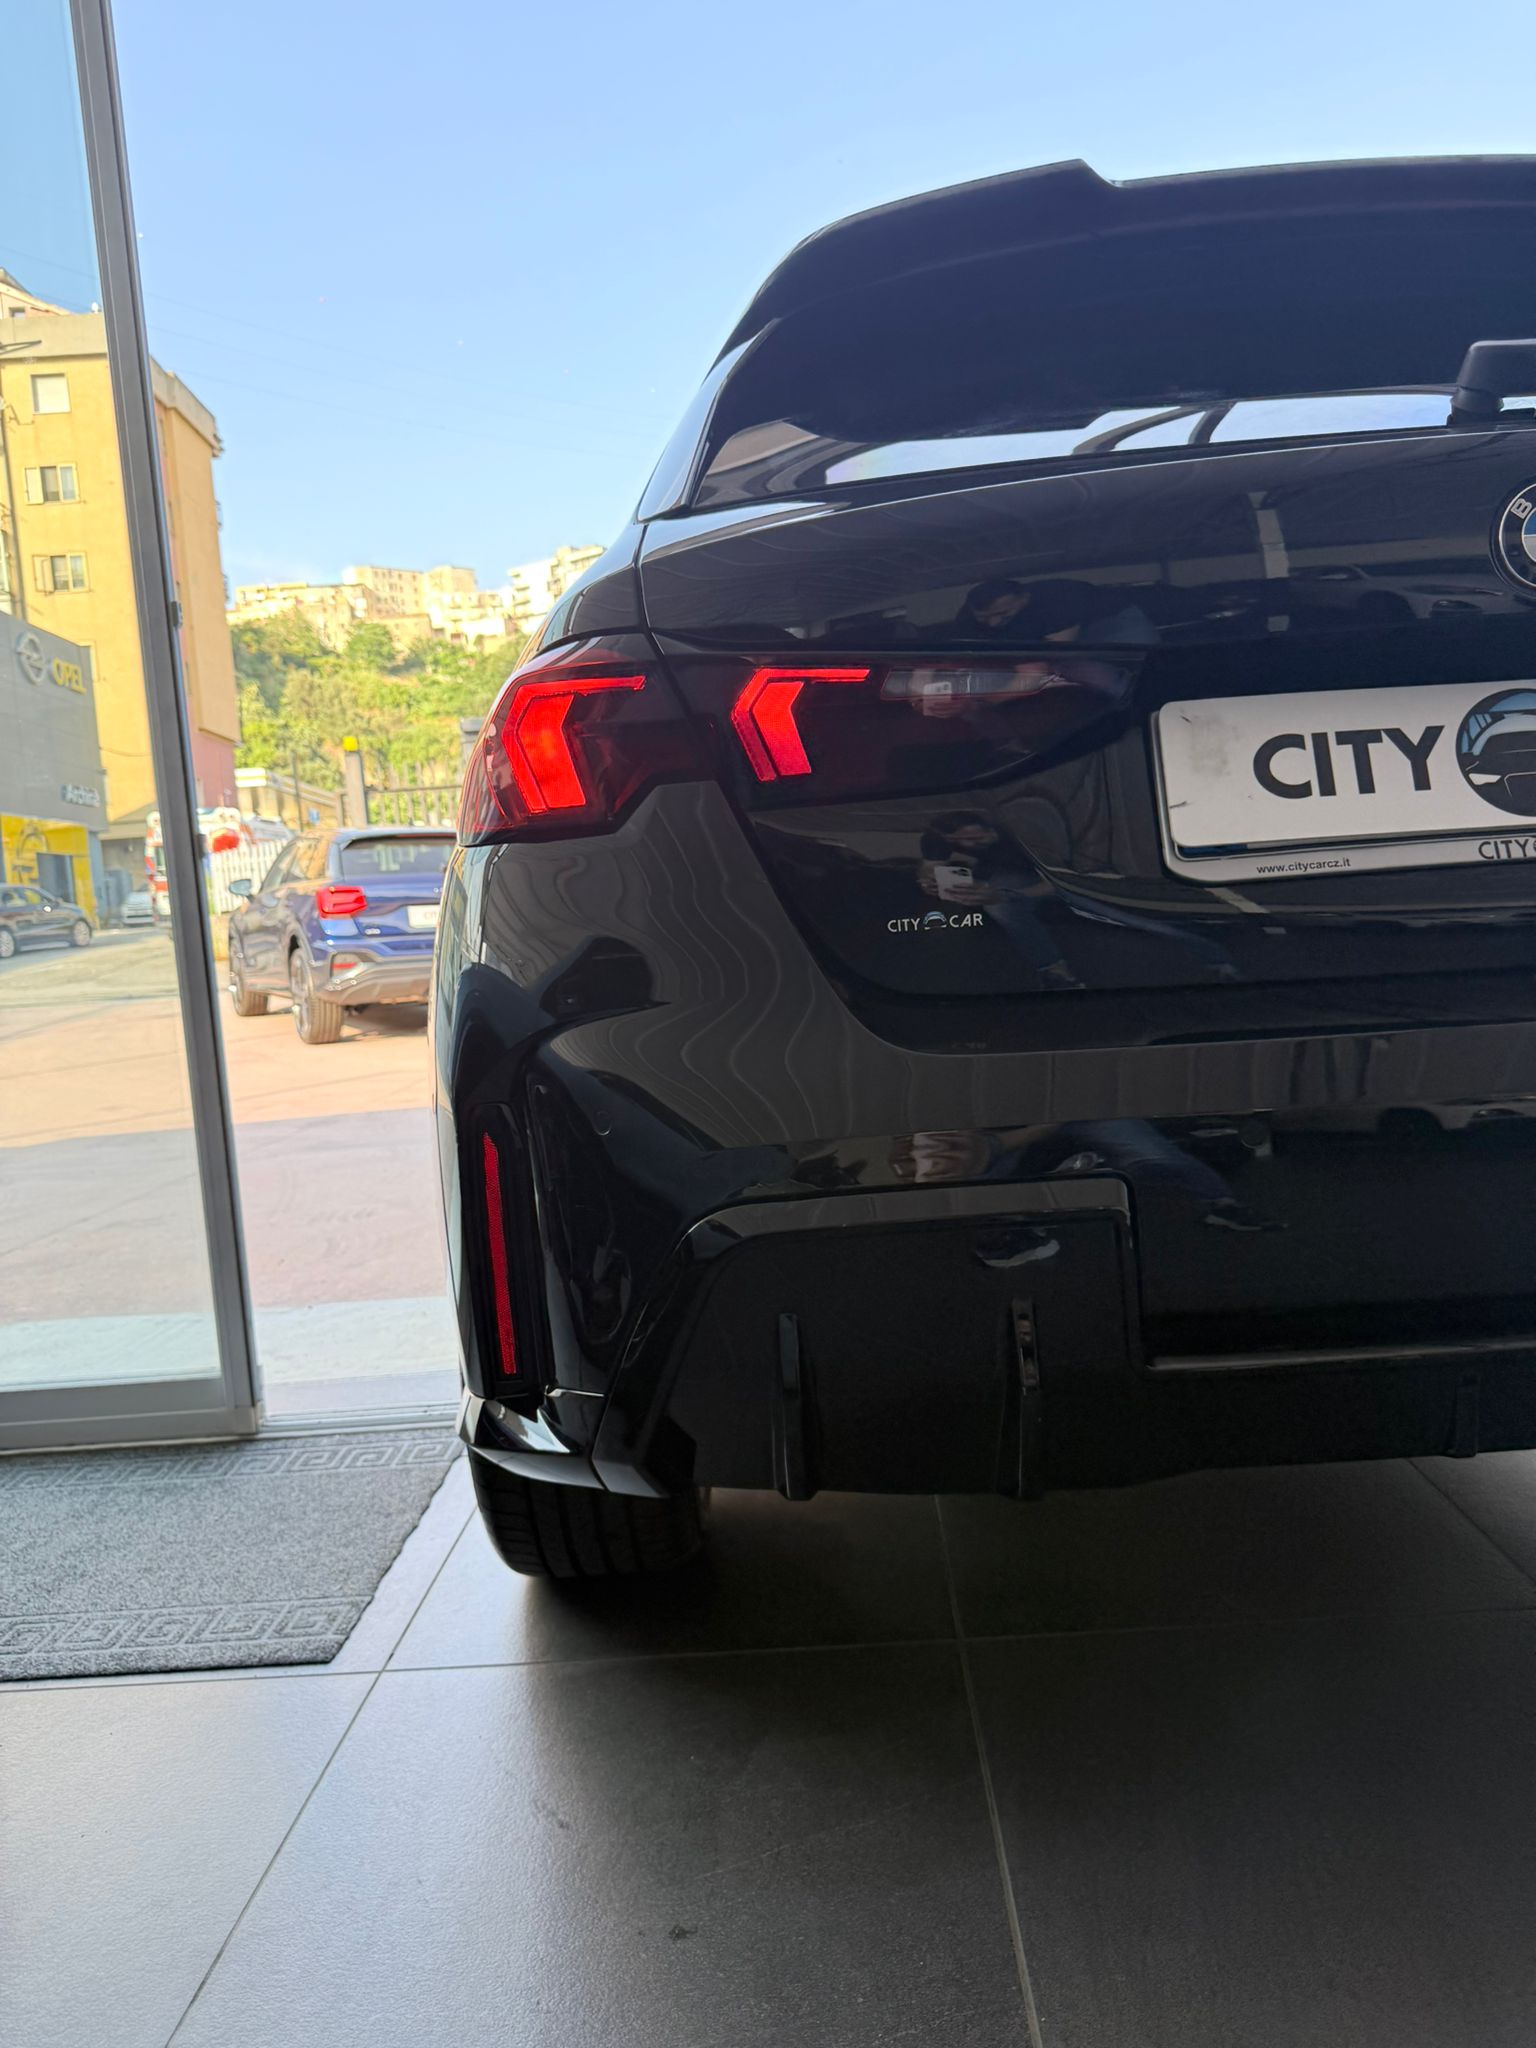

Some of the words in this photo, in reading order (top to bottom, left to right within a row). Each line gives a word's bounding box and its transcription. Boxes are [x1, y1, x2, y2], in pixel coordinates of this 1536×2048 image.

[52, 657, 87, 694] OPEL
[1253, 725, 1445, 800] CITY
[1478, 839, 1529, 860] CITY
[1256, 858, 1351, 874] www.citycarcz.it
[887, 918, 921, 933] CITY
[949, 913, 984, 928] CAR
